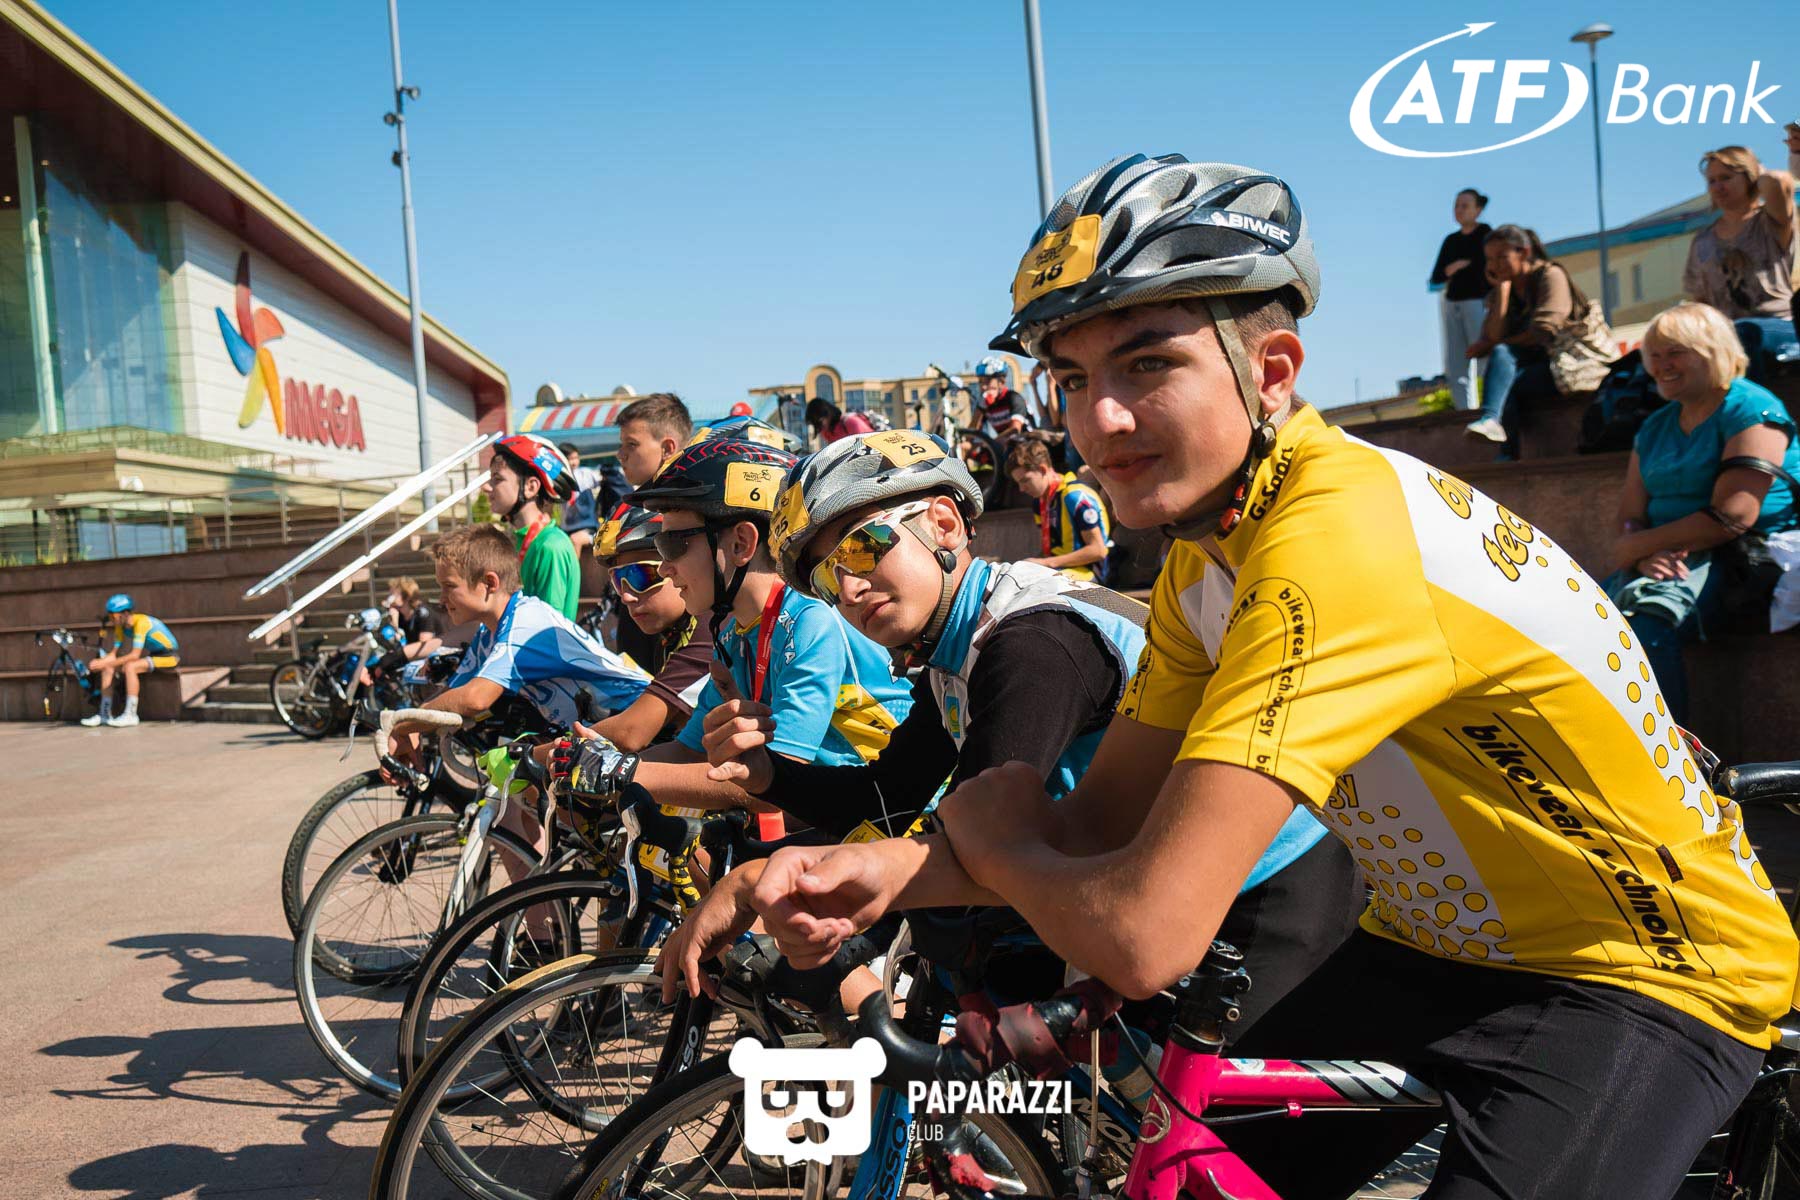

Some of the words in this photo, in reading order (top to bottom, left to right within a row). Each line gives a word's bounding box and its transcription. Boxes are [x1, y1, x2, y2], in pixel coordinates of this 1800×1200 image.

[284, 376, 366, 452] MEGA
[901, 443, 926, 456] 25
[749, 487, 761, 502] 6
[1482, 503, 1534, 582] tec
[617, 757, 636, 776] FILA
